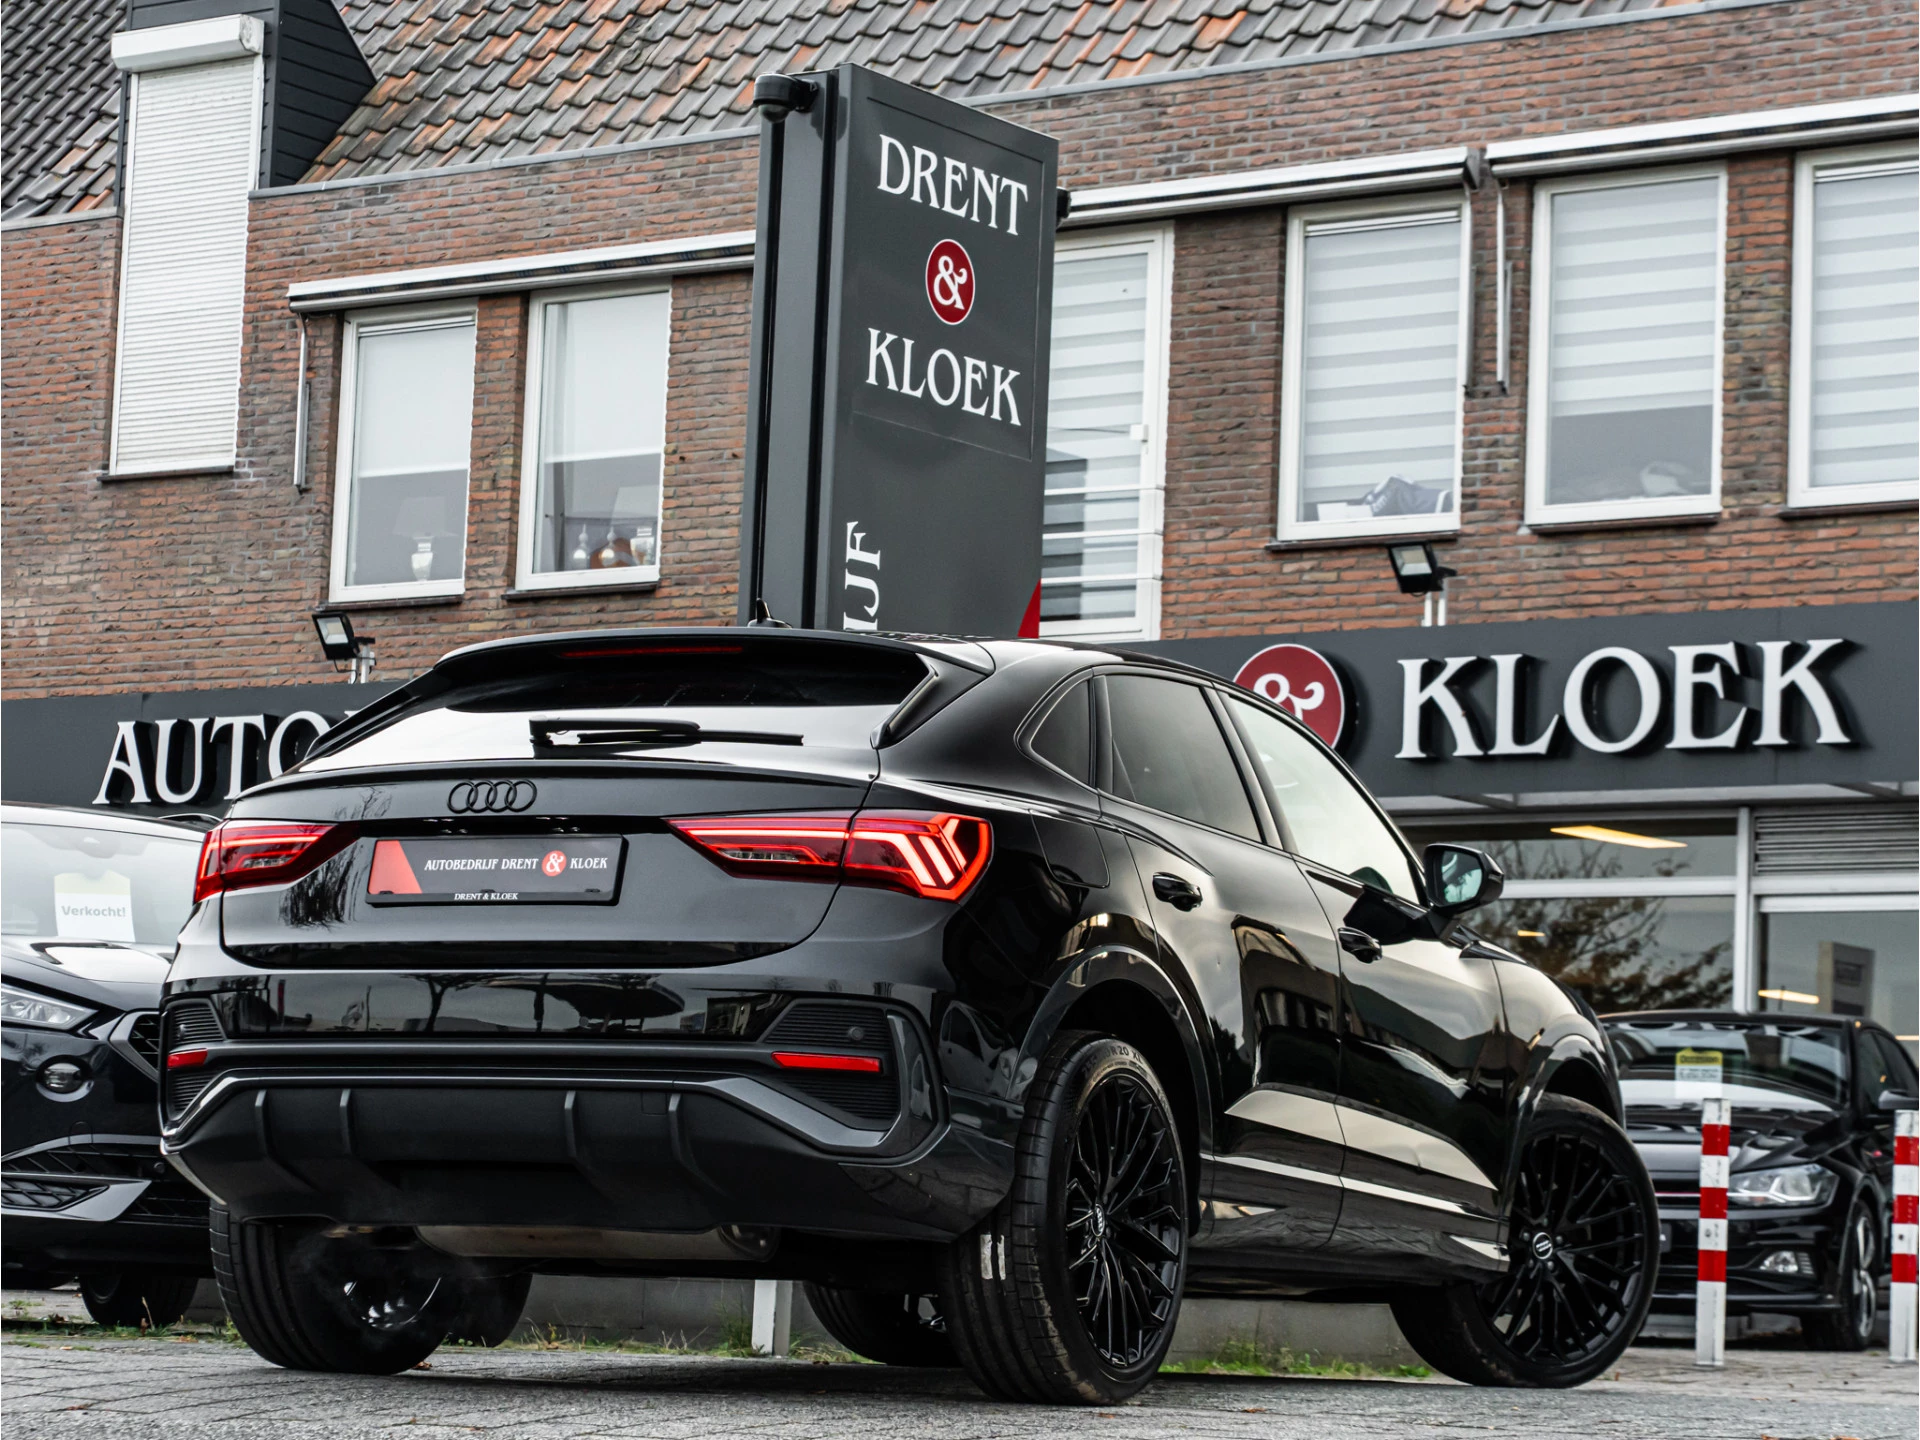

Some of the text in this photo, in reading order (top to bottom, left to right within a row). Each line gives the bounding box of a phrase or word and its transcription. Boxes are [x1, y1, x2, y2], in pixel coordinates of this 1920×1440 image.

[877, 133, 1028, 236] DRENT
[933, 255, 967, 310] &
[865, 327, 1022, 426] KLOEK
[1395, 638, 1852, 759] KLOEK
[92, 710, 359, 805] AUTO
[424, 853, 608, 873] AUTOBEDRIJF DRENT & KLOEK
[61, 905, 126, 918] Verkocht!
